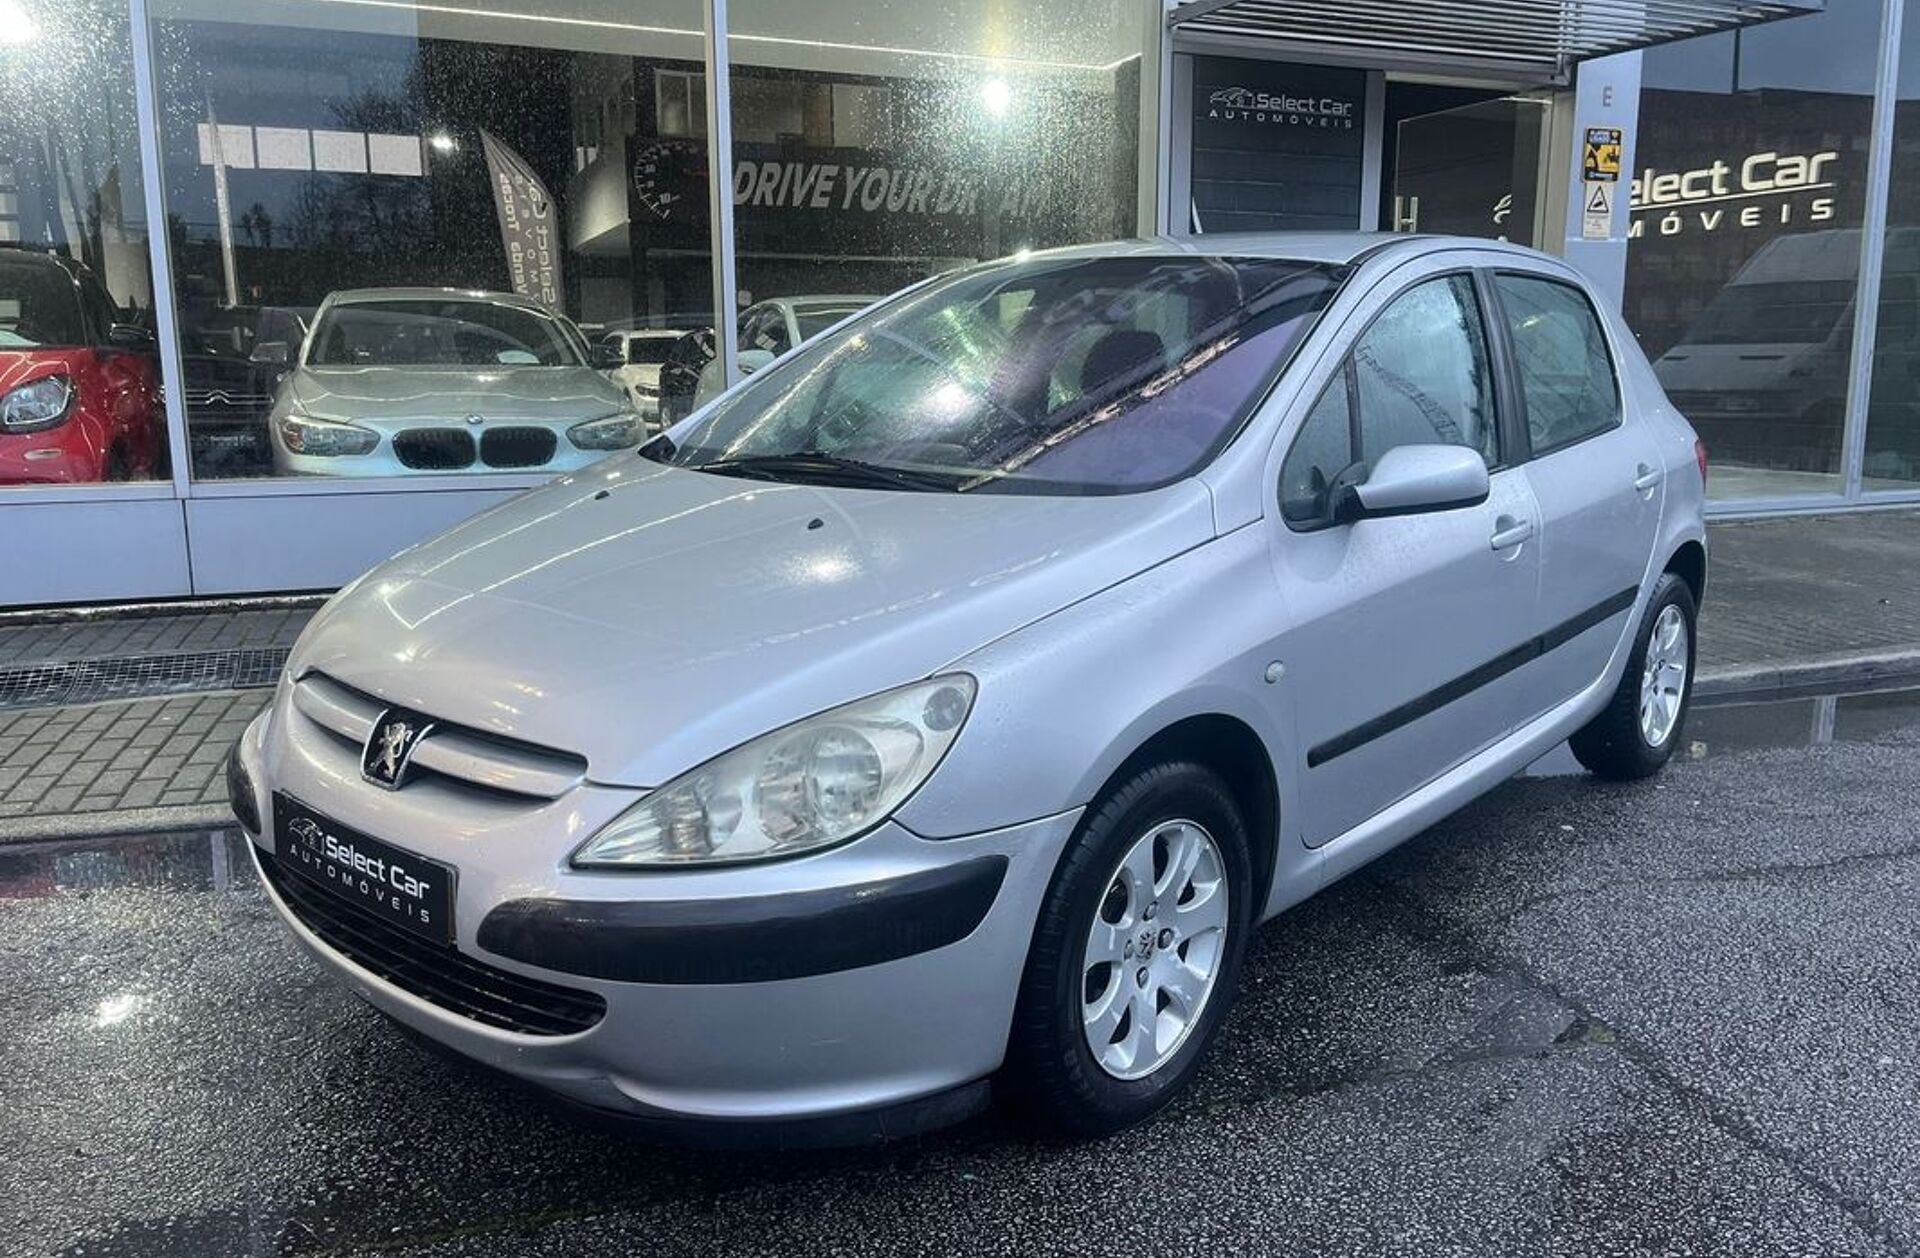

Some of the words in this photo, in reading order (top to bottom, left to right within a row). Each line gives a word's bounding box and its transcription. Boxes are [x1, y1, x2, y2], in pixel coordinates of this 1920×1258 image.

[1257, 93, 1315, 112] Select
[1319, 99, 1353, 115] Car
[1602, 86, 1613, 107] E
[733, 160, 840, 208] DRIVE
[841, 165, 933, 214] YOUR
[934, 168, 1051, 218] DRAM
[1629, 160, 1732, 206] elect
[1741, 151, 1840, 191] Car
[1627, 198, 1836, 239] MÓVEIS
[325, 834, 387, 883] Select
[390, 864, 431, 900] Car
